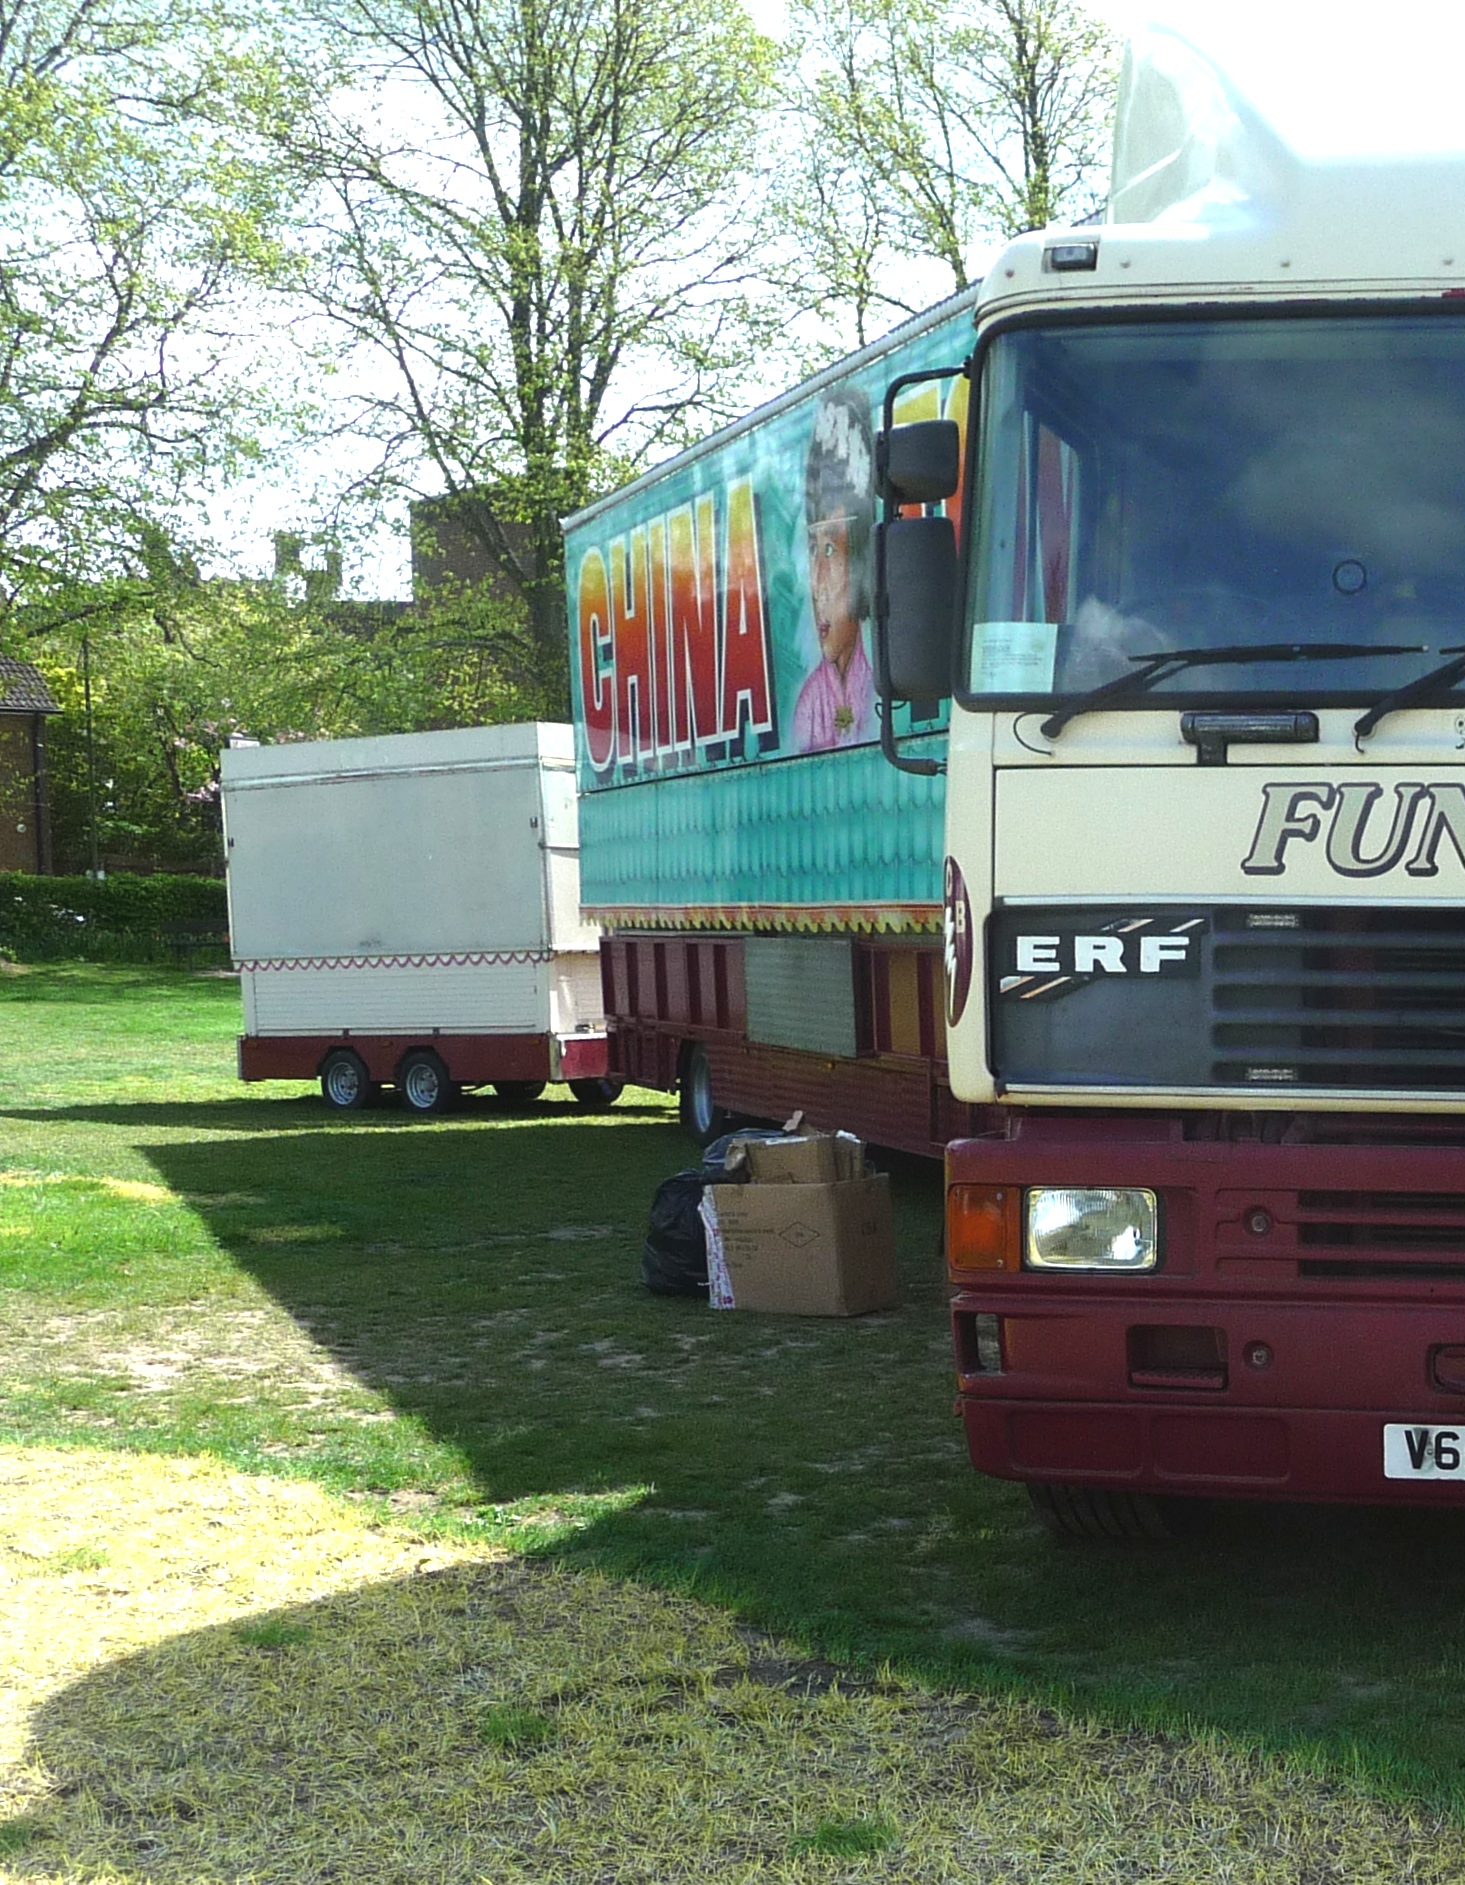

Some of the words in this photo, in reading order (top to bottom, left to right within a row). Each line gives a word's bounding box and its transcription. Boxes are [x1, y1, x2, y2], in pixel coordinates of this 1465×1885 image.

[578, 474, 776, 775] CHINA
[955, 900, 966, 933] B
[1016, 935, 1190, 973] ERF
